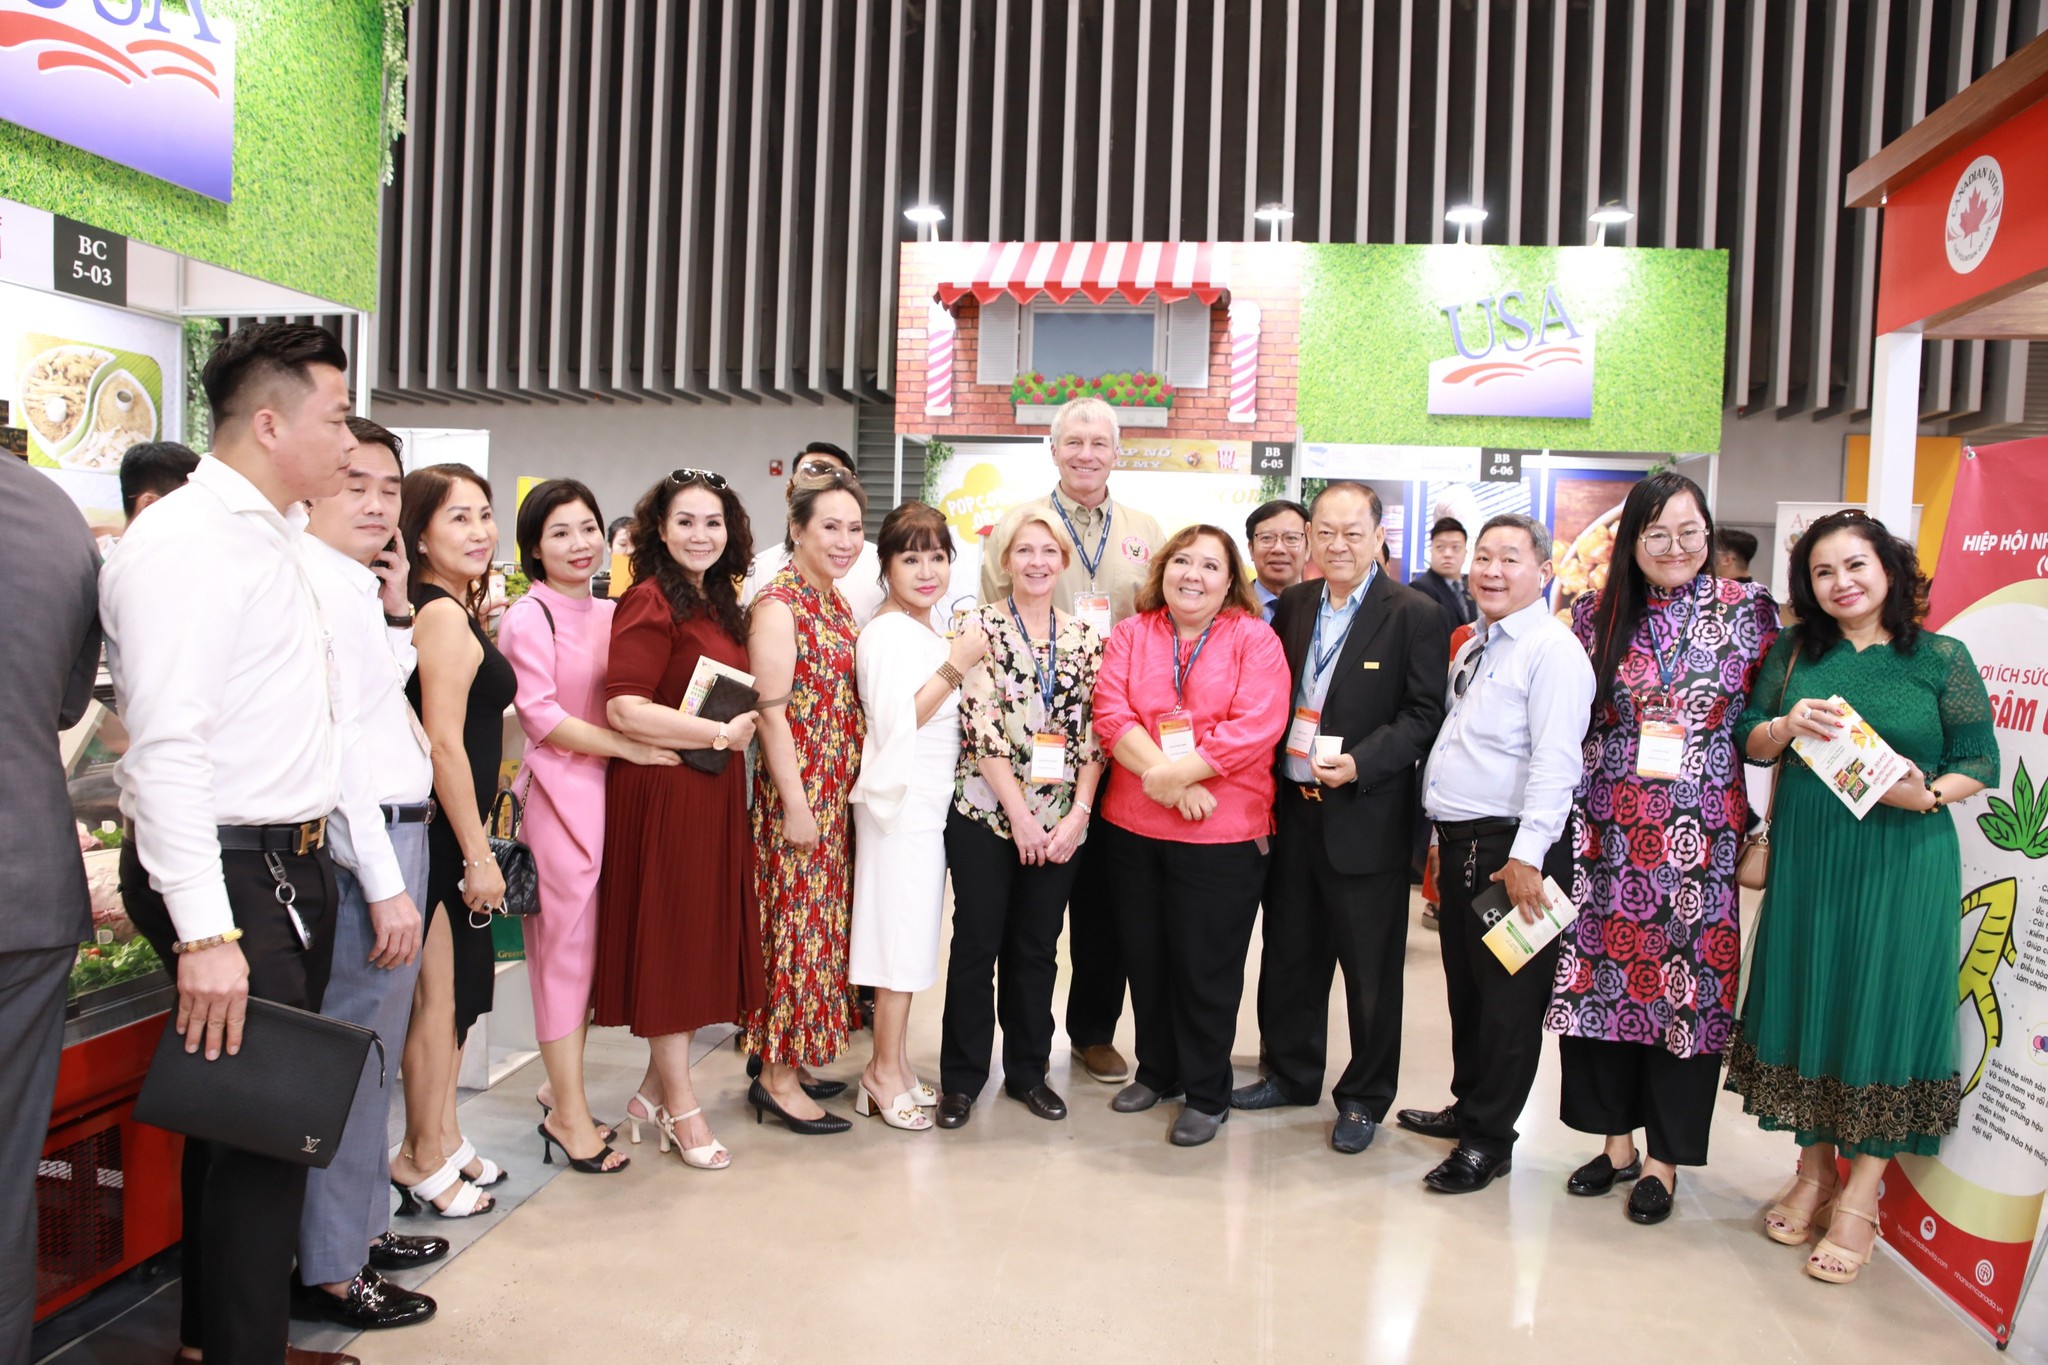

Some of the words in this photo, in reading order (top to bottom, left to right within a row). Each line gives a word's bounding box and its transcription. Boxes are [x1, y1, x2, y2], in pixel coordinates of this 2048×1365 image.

[1951, 167, 1988, 218] CANADIAN
[78, 234, 107, 261] BC
[72, 260, 112, 286] 5-03
[1440, 284, 1584, 360] USA
[1260, 459, 1284, 469] 6-05
[1265, 447, 1281, 457] BB
[1494, 453, 1510, 463] BB
[1490, 465, 1514, 476] 6-06
[1962, 530, 1998, 556] HIỆP
[1999, 529, 2028, 555] HỘI
[1996, 664, 2020, 683] ÍCH
[1988, 689, 2039, 733] SÂM
[2016, 973, 2029, 984] Làm
[2029, 980, 2047, 992] chậm
[1991, 1059, 2003, 1070] Sức
[2020, 1074, 2034, 1086] sinh
[1998, 1076, 2011, 1087] sinh
[2011, 1083, 2026, 1095] nam
[2027, 1091, 2036, 1101] và
[1974, 1113, 1988, 1126] Bình
[1981, 1091, 1995, 1104] Các
[2010, 1108, 2031, 1126] chứng
[2031, 1119, 2044, 1133] hậu
[1993, 1111, 2006, 1124] kinh
